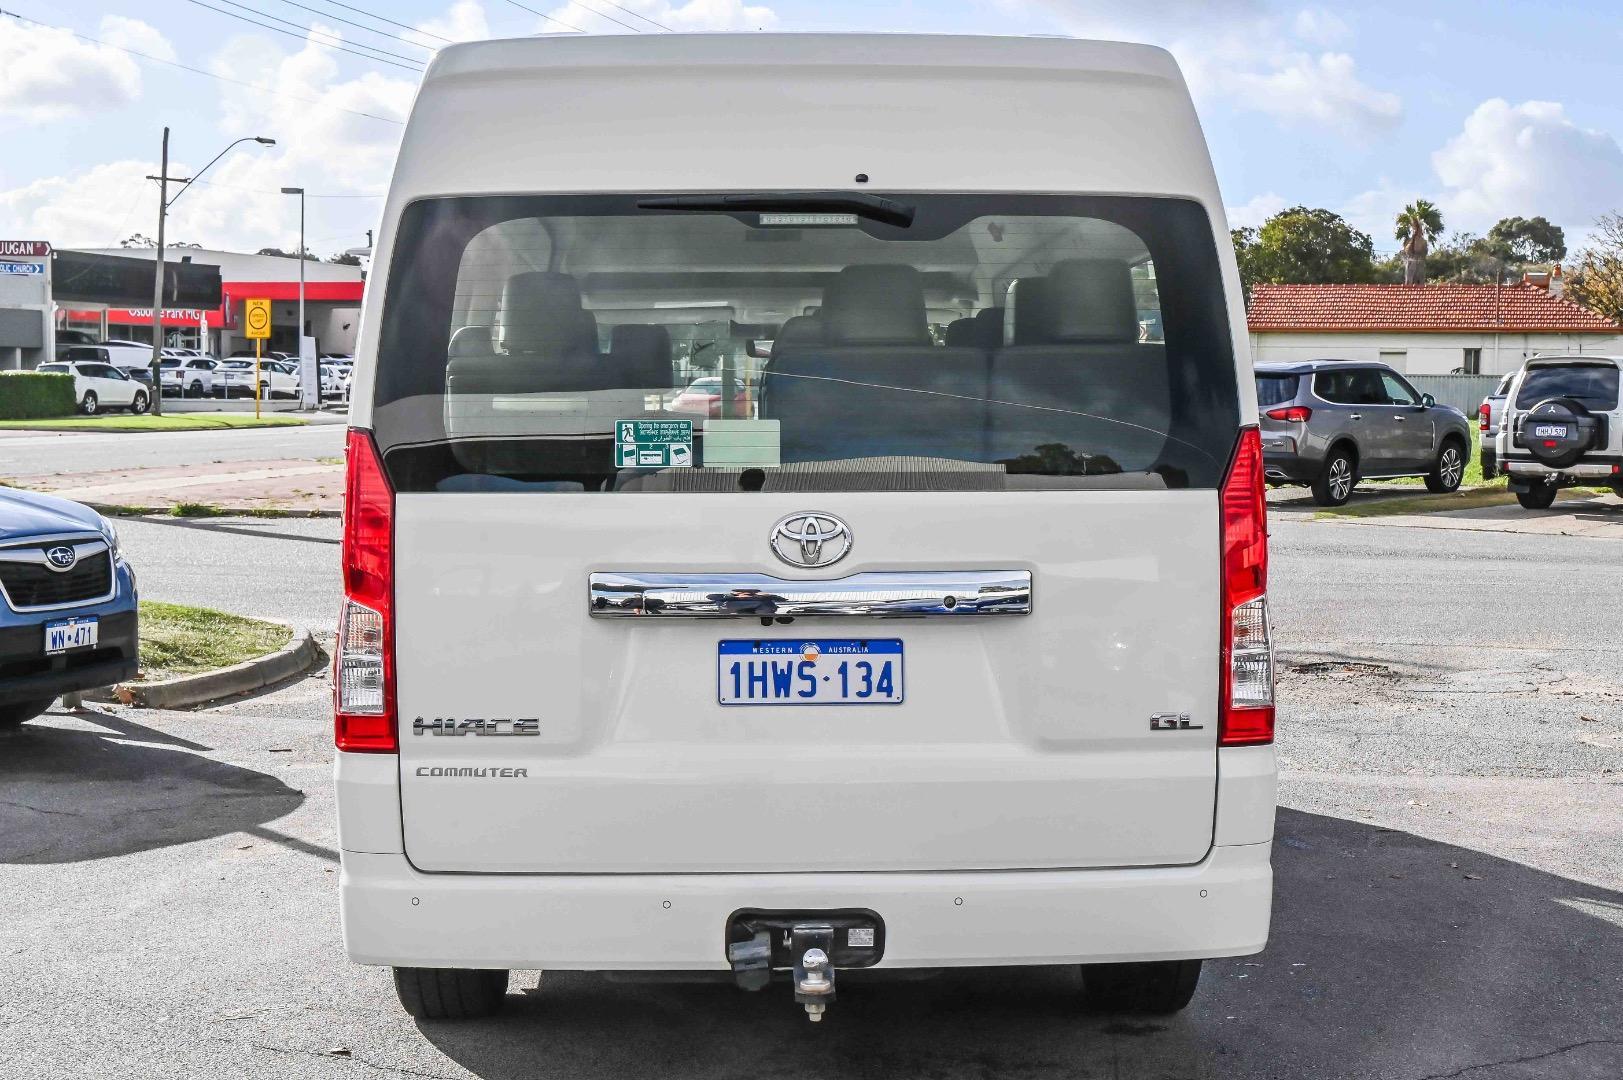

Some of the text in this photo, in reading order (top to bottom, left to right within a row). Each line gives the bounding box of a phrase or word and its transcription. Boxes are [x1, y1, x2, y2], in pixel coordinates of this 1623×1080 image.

[12, 264, 33, 273] CHURCH
[186, 310, 200, 320] MG
[828, 646, 869, 654] AUSTRALIA
[1150, 712, 1203, 730] GL
[413, 718, 541, 736] HIACE
[416, 767, 528, 777] COMMUTER
